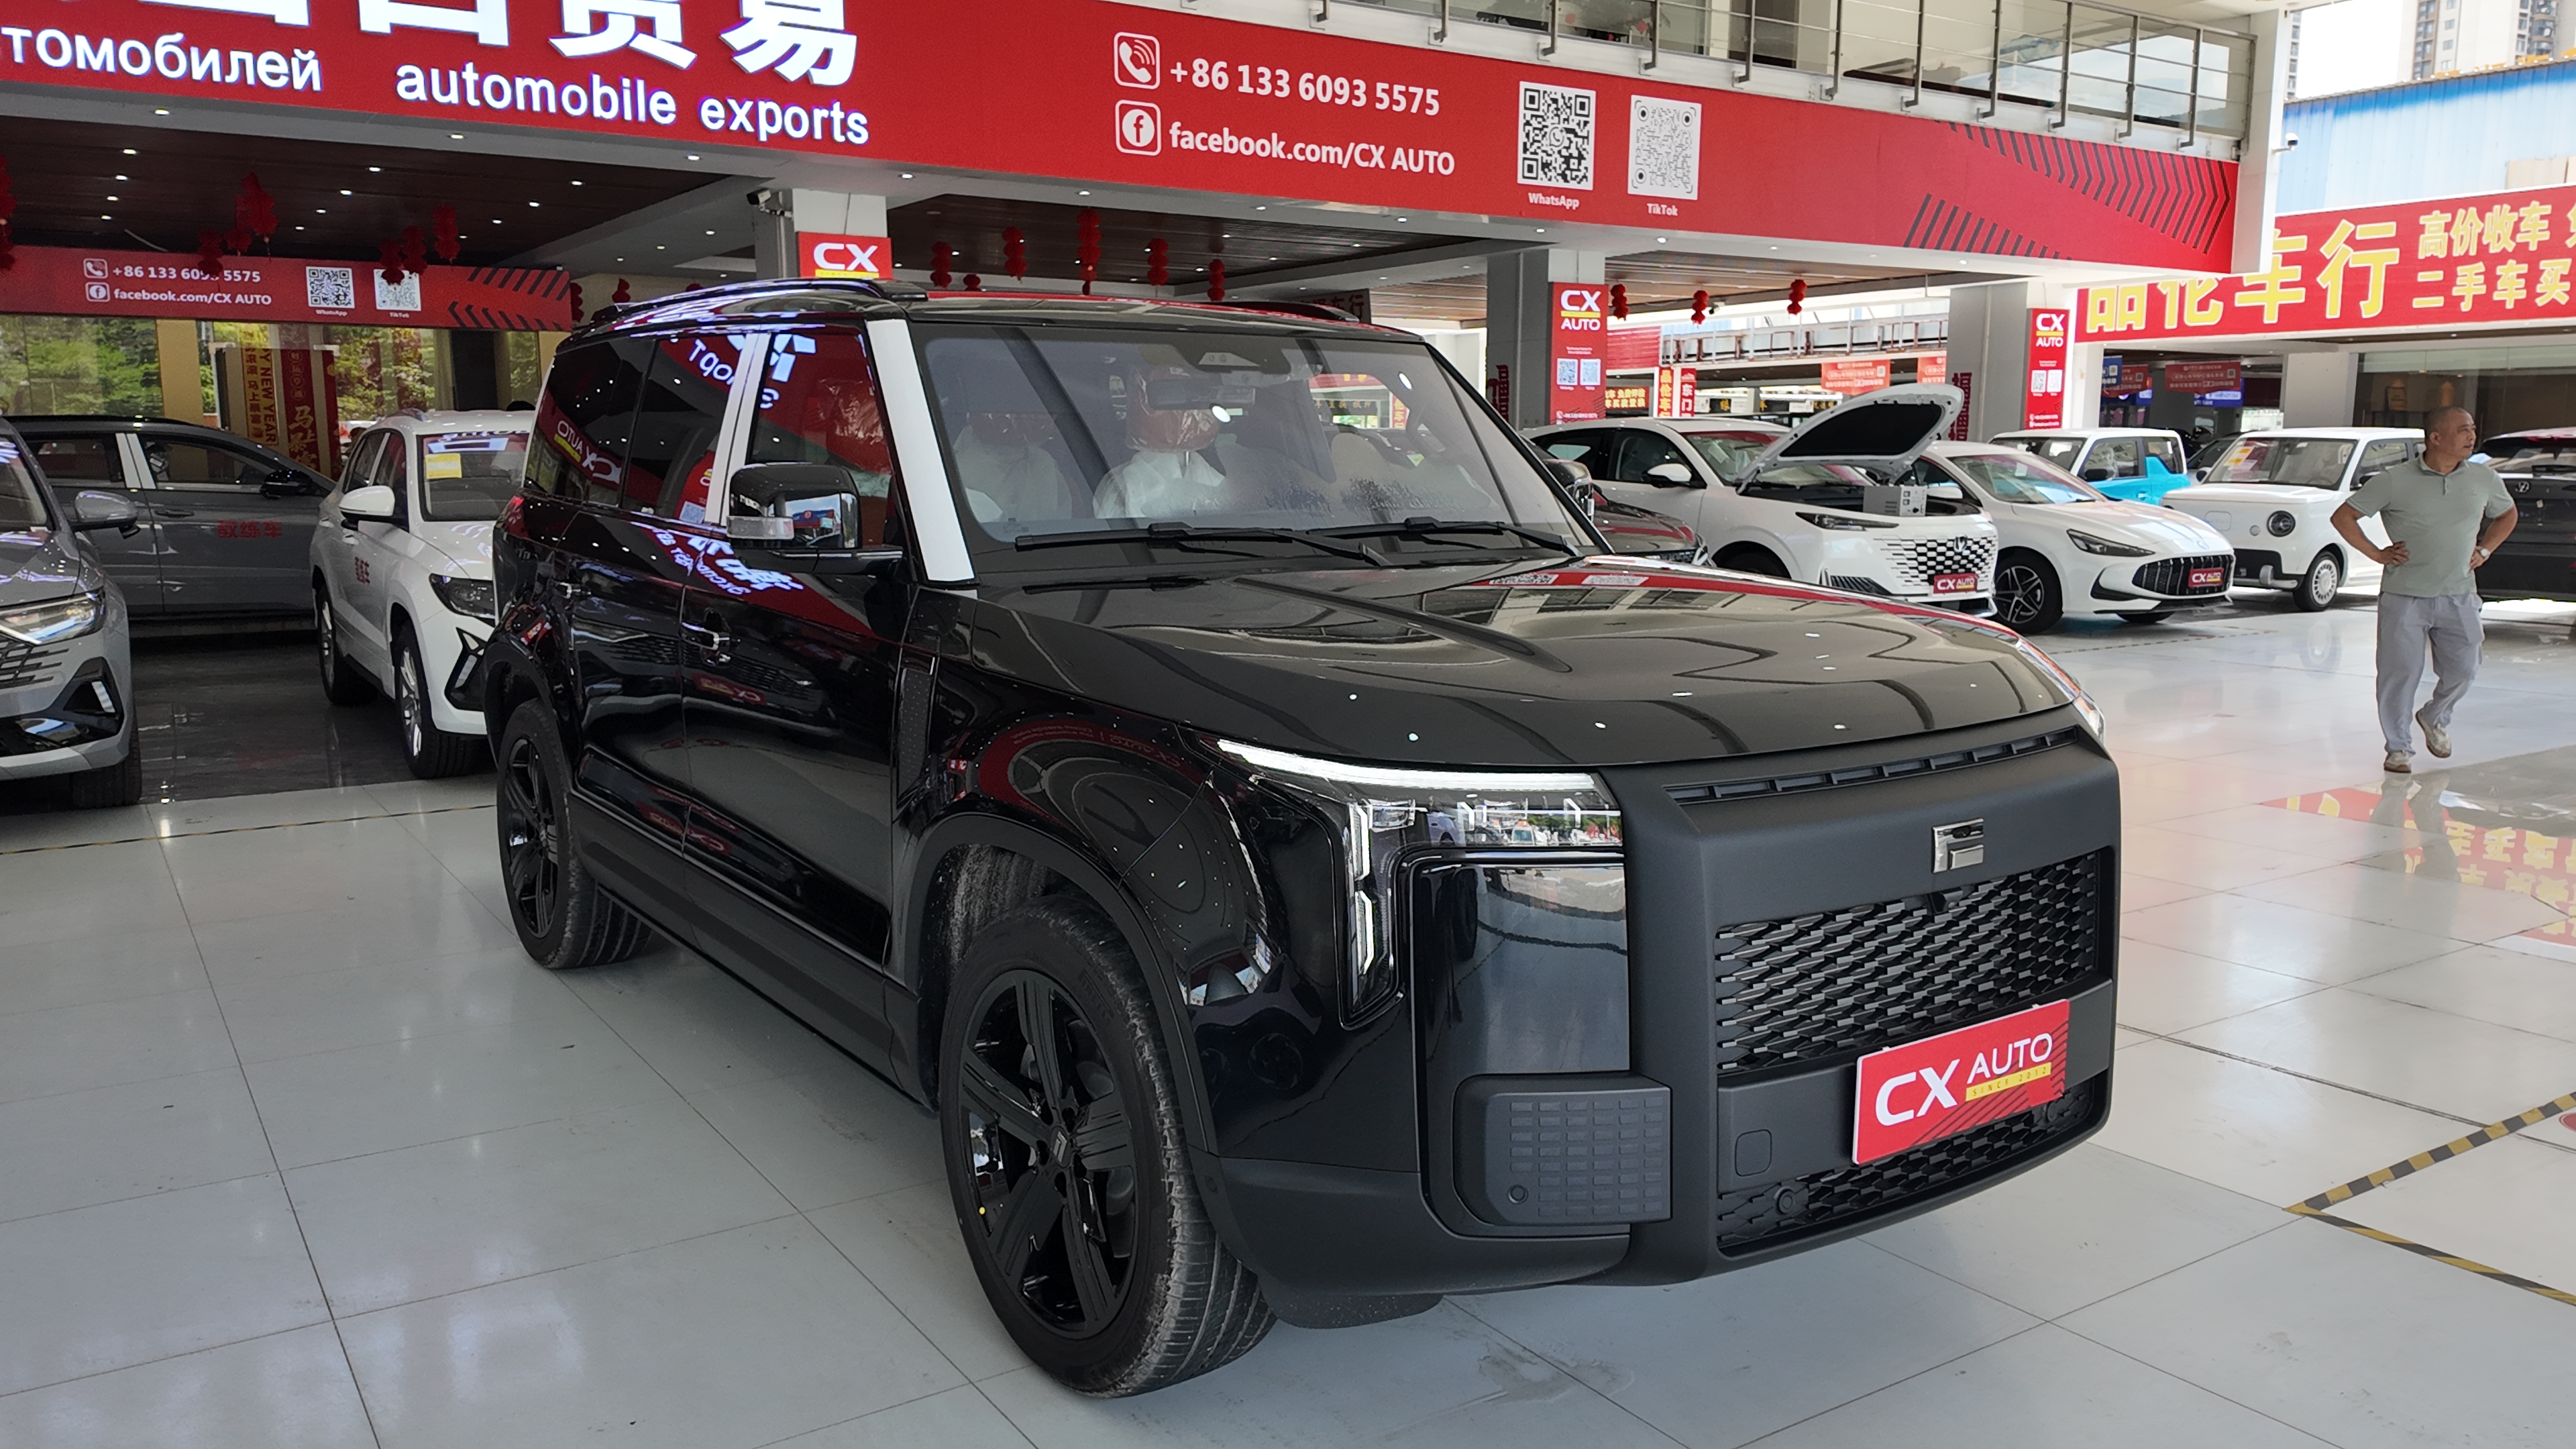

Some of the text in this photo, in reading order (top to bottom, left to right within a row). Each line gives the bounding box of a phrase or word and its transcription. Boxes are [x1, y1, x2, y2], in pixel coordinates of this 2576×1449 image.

[1, 26, 323, 91] томобилей
[1170, 58, 1440, 116] +86 133 6093 5575
[396, 62, 869, 144] automobile exports
[1169, 122, 1455, 175] facebook.com/CX AUTO
[1528, 193, 1580, 210] WhatsApp
[1646, 203, 1678, 216] TikTok
[2418, 200, 2552, 260] 高价收车
[813, 242, 879, 272] CX
[113, 266, 260, 282] +86 133 60 5575
[2412, 258, 2572, 312] 二手车买
[114, 288, 272, 305] facebook.com/CX AUTO
[1560, 289, 1602, 312] CX
[1560, 318, 1601, 331] AUTO
[2036, 313, 2065, 331] CX
[2036, 337, 2063, 347] AUTO
[260, 367, 273, 400] NEW
[264, 404, 276, 443] YEAR
[1937, 577, 1975, 590] CX AUTO
[2192, 572, 2206, 583] CX
[1876, 1033, 2053, 1126] CX AUTO
[1972, 1066, 2047, 1097] SINCE 2012
